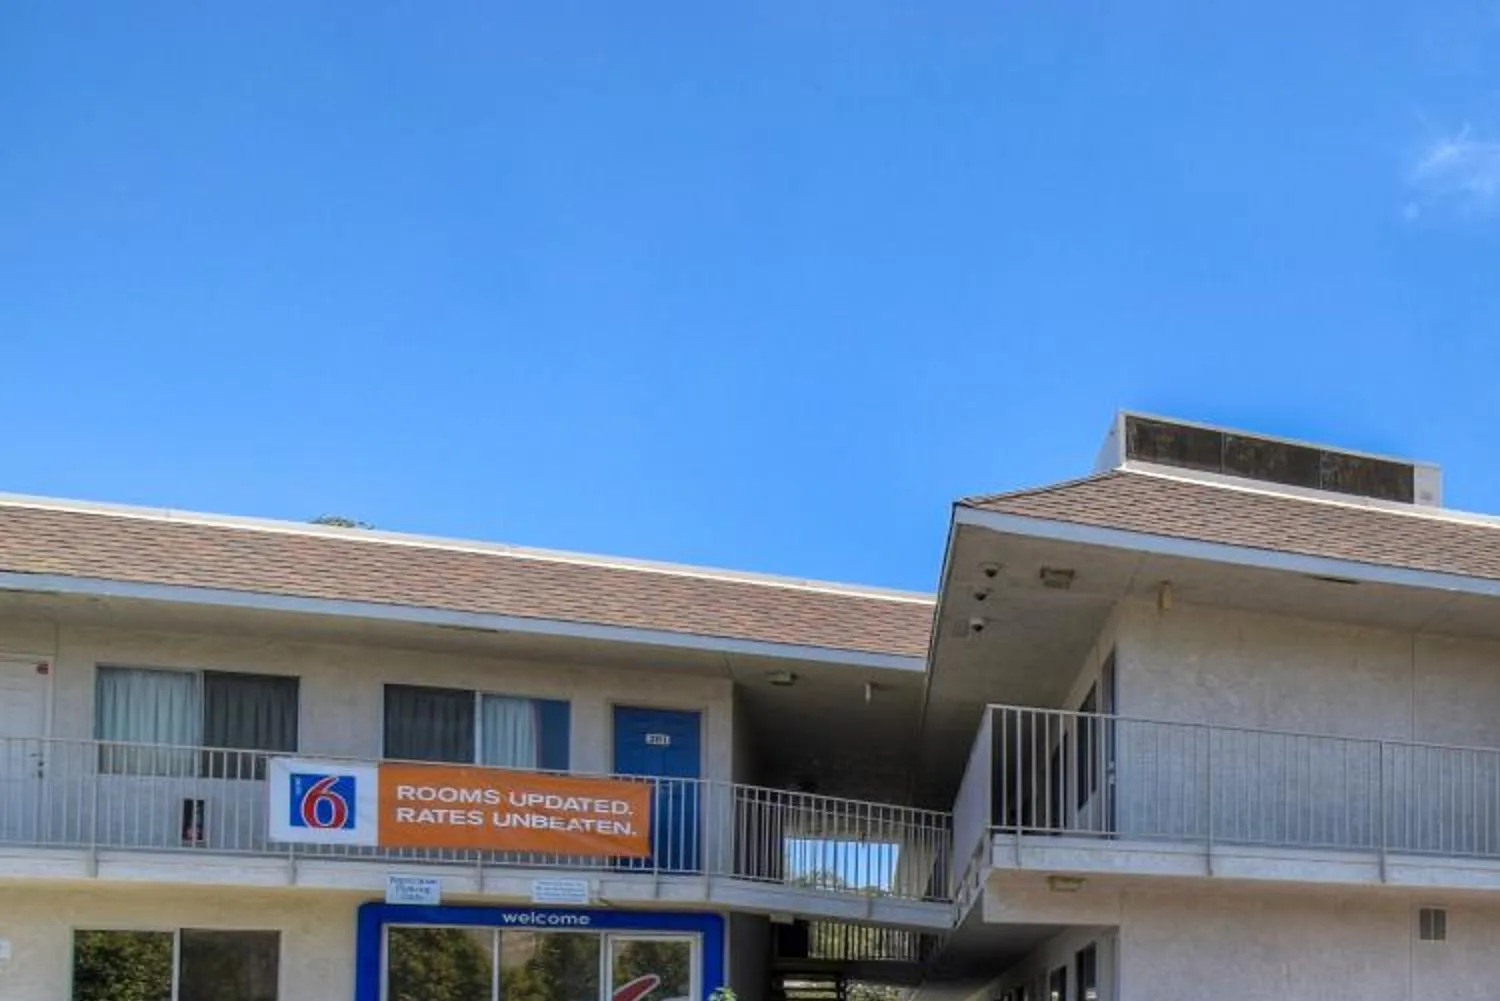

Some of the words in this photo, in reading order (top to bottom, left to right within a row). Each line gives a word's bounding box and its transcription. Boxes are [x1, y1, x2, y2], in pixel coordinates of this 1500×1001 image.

[301, 776, 348, 829] 6
[397, 785, 500, 805] ROOMS
[508, 791, 634, 816] UPDATED.
[396, 807, 484, 826] RATES
[492, 813, 638, 837] UNBEATEN.
[502, 911, 591, 925] welcome
